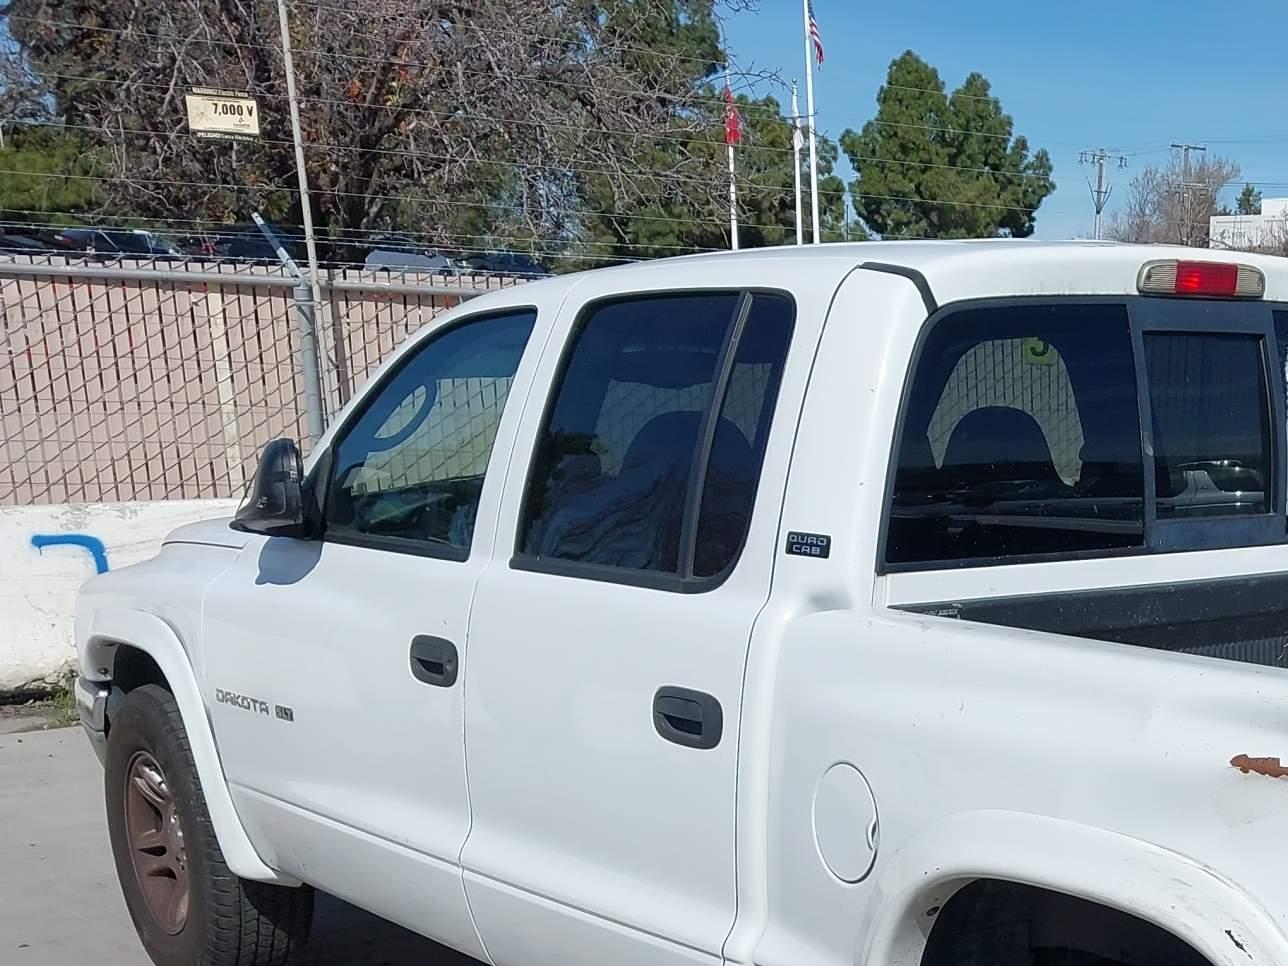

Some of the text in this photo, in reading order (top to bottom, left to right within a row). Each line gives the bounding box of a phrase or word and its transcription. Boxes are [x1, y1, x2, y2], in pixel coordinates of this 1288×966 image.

[212, 103, 253, 117] 7,000 V
[789, 534, 827, 546] QUAD
[792, 544, 820, 555] CAB
[216, 688, 269, 716] DAKOTA
